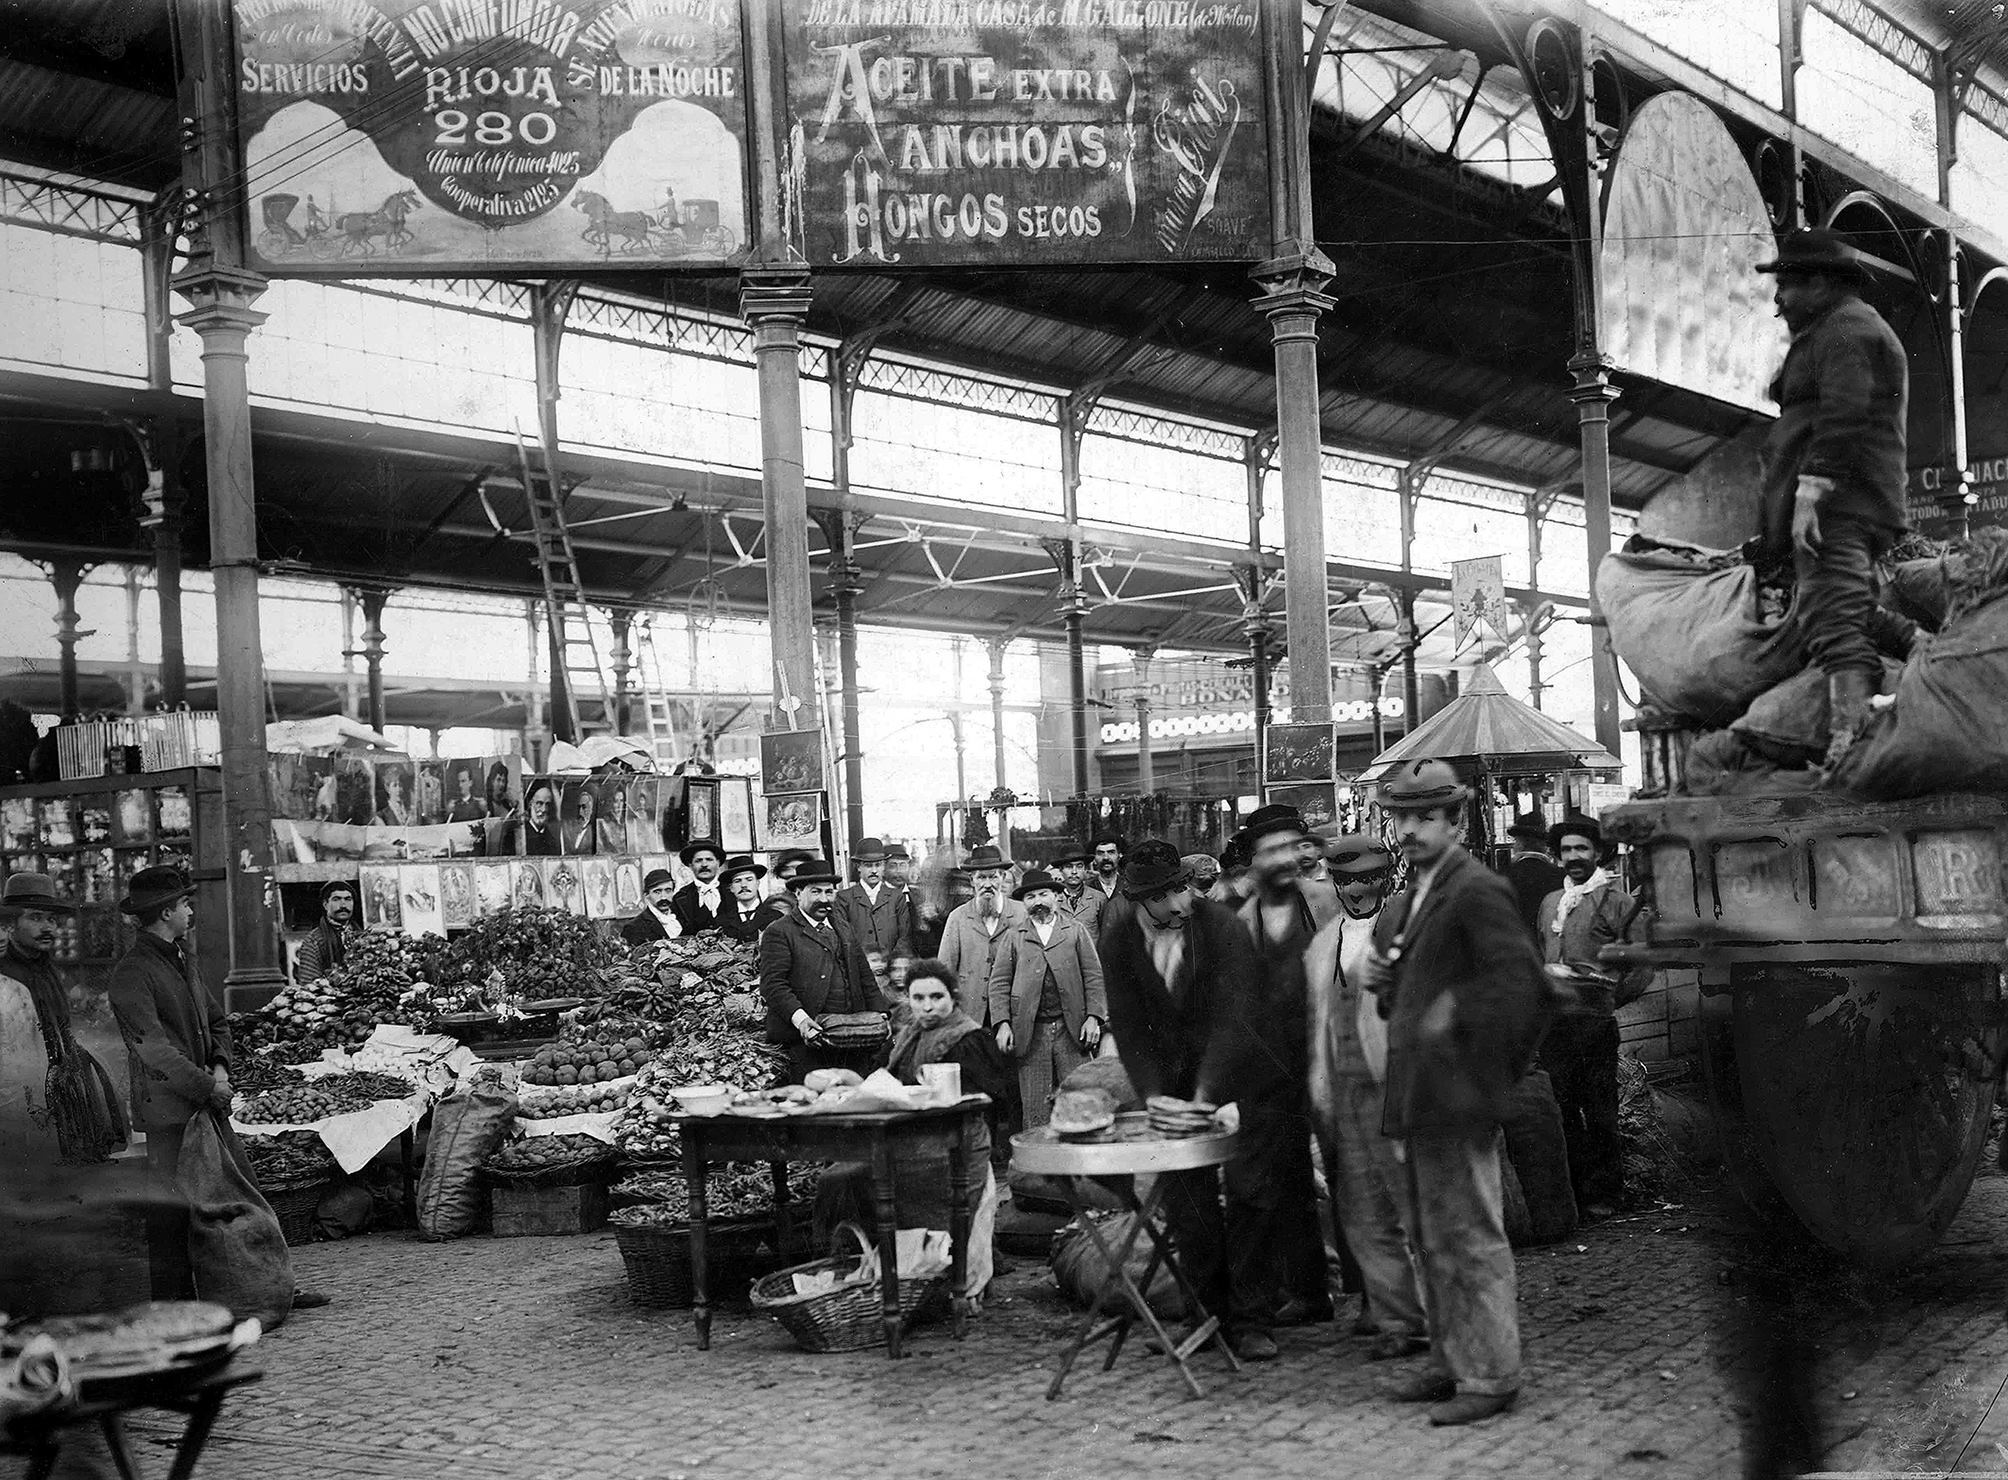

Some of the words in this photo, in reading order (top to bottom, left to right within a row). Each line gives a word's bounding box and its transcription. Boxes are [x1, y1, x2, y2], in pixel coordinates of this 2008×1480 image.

[401, 4, 451, 60] NO
[241, 57, 369, 94] SERVICIOS
[423, 65, 563, 113] RIOJA
[566, 55, 598, 91] SE
[600, 66, 624, 97] DE
[628, 66, 655, 97] LA
[657, 62, 735, 99] NOCHE
[810, 34, 998, 167] ACEITE
[1010, 68, 1117, 101] EXTRA
[434, 109, 557, 145] 280
[899, 123, 1108, 170] ANCHOAS
[440, 175, 528, 217] Cooperativa
[832, 147, 1009, 264] HONGOS
[1017, 204, 1102, 238] SECOS
